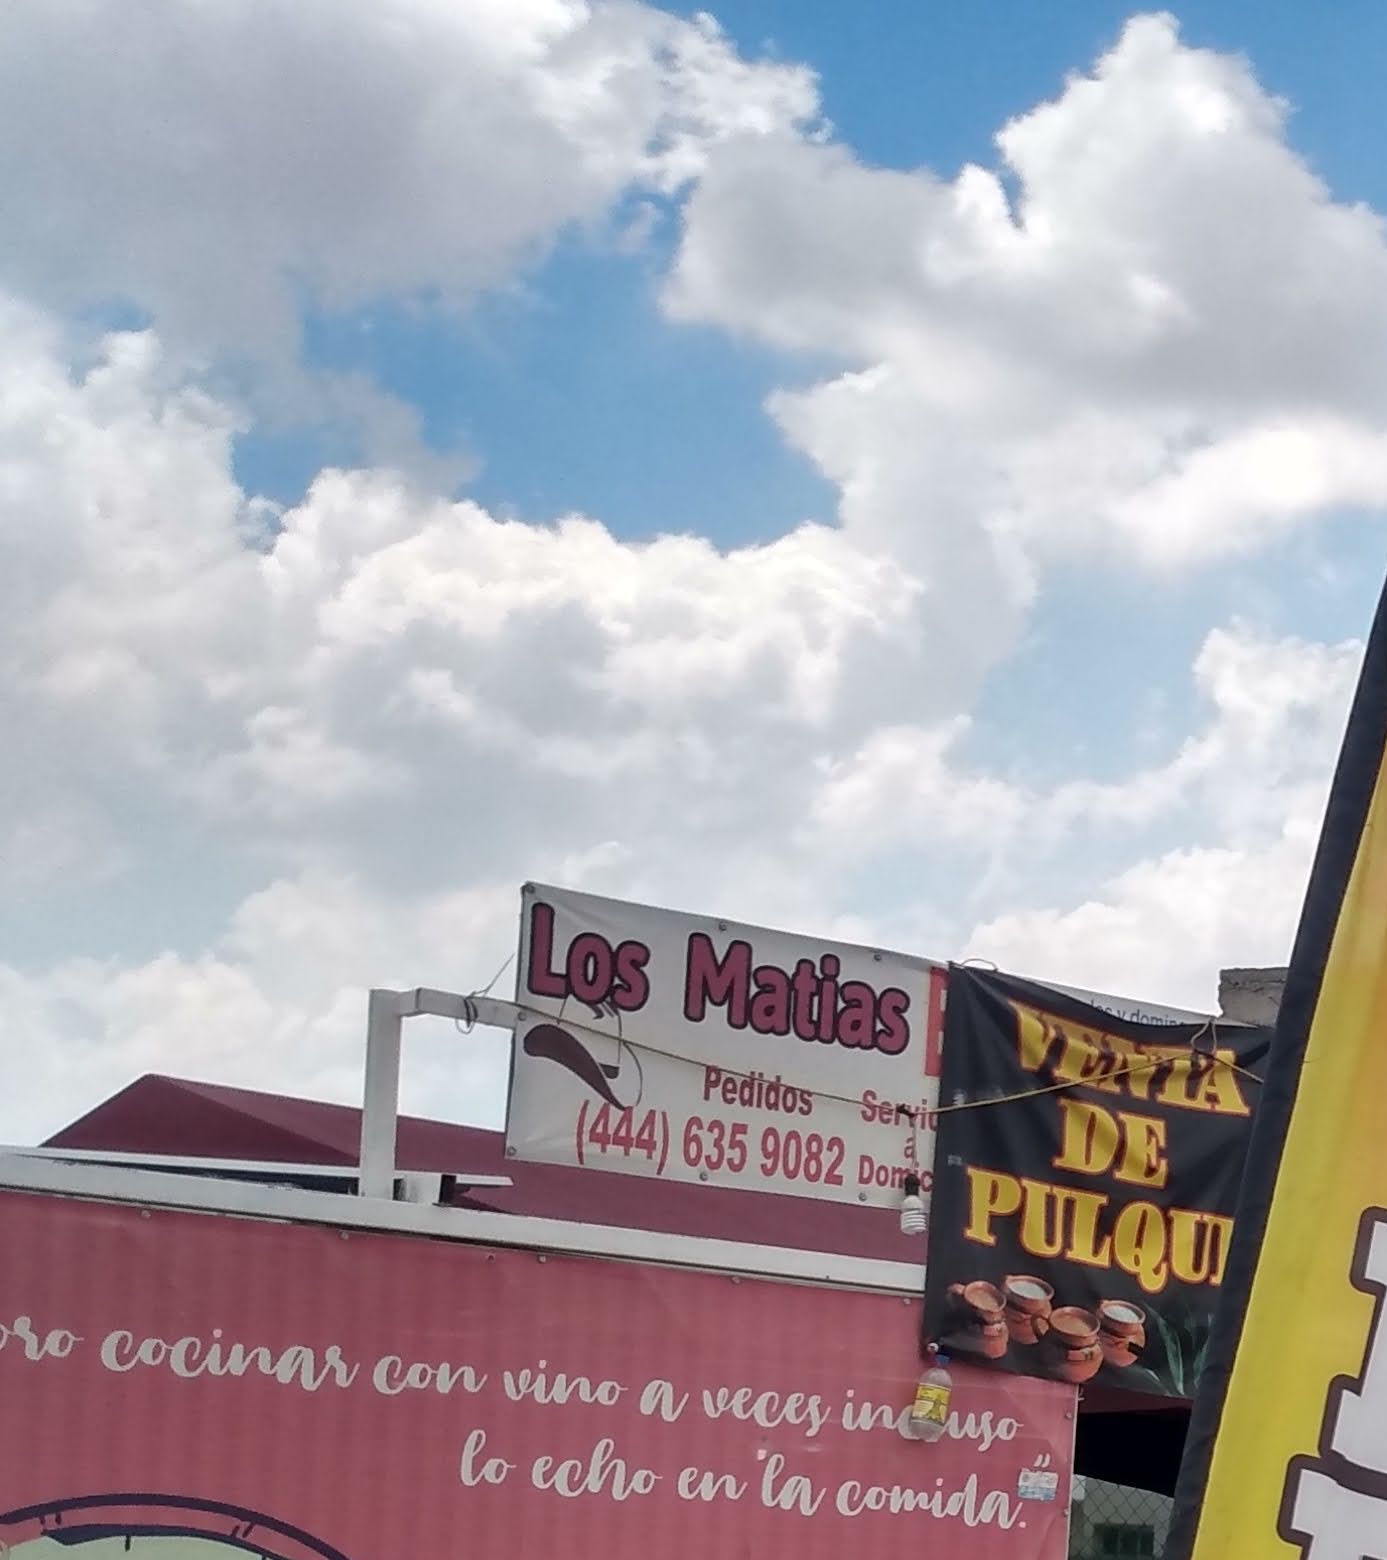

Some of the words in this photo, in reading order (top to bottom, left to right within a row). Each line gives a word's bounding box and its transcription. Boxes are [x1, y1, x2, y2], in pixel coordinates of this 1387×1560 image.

[528, 902, 650, 1012] Los
[684, 932, 910, 1056] Matias
[703, 1065, 813, 1116] Pedidos
[1008, 998, 1250, 1116] VENTA
[576, 1099, 669, 1175] (444)
[683, 1116, 749, 1173] 635
[760, 1127, 845, 1186] 9082
[1052, 1098, 1169, 1188] DE
[101, 1329, 359, 1391] cocinar
[372, 1355, 487, 1395] con
[504, 1359, 628, 1406] vino
[639, 1378, 689, 1422] a
[703, 1384, 831, 1437] veces
[842, 1379, 1024, 1452] incuso
[460, 1429, 516, 1486] lo
[532, 1438, 662, 1501] echo
[678, 1465, 748, 1502] en
[760, 1453, 826, 1516] la
